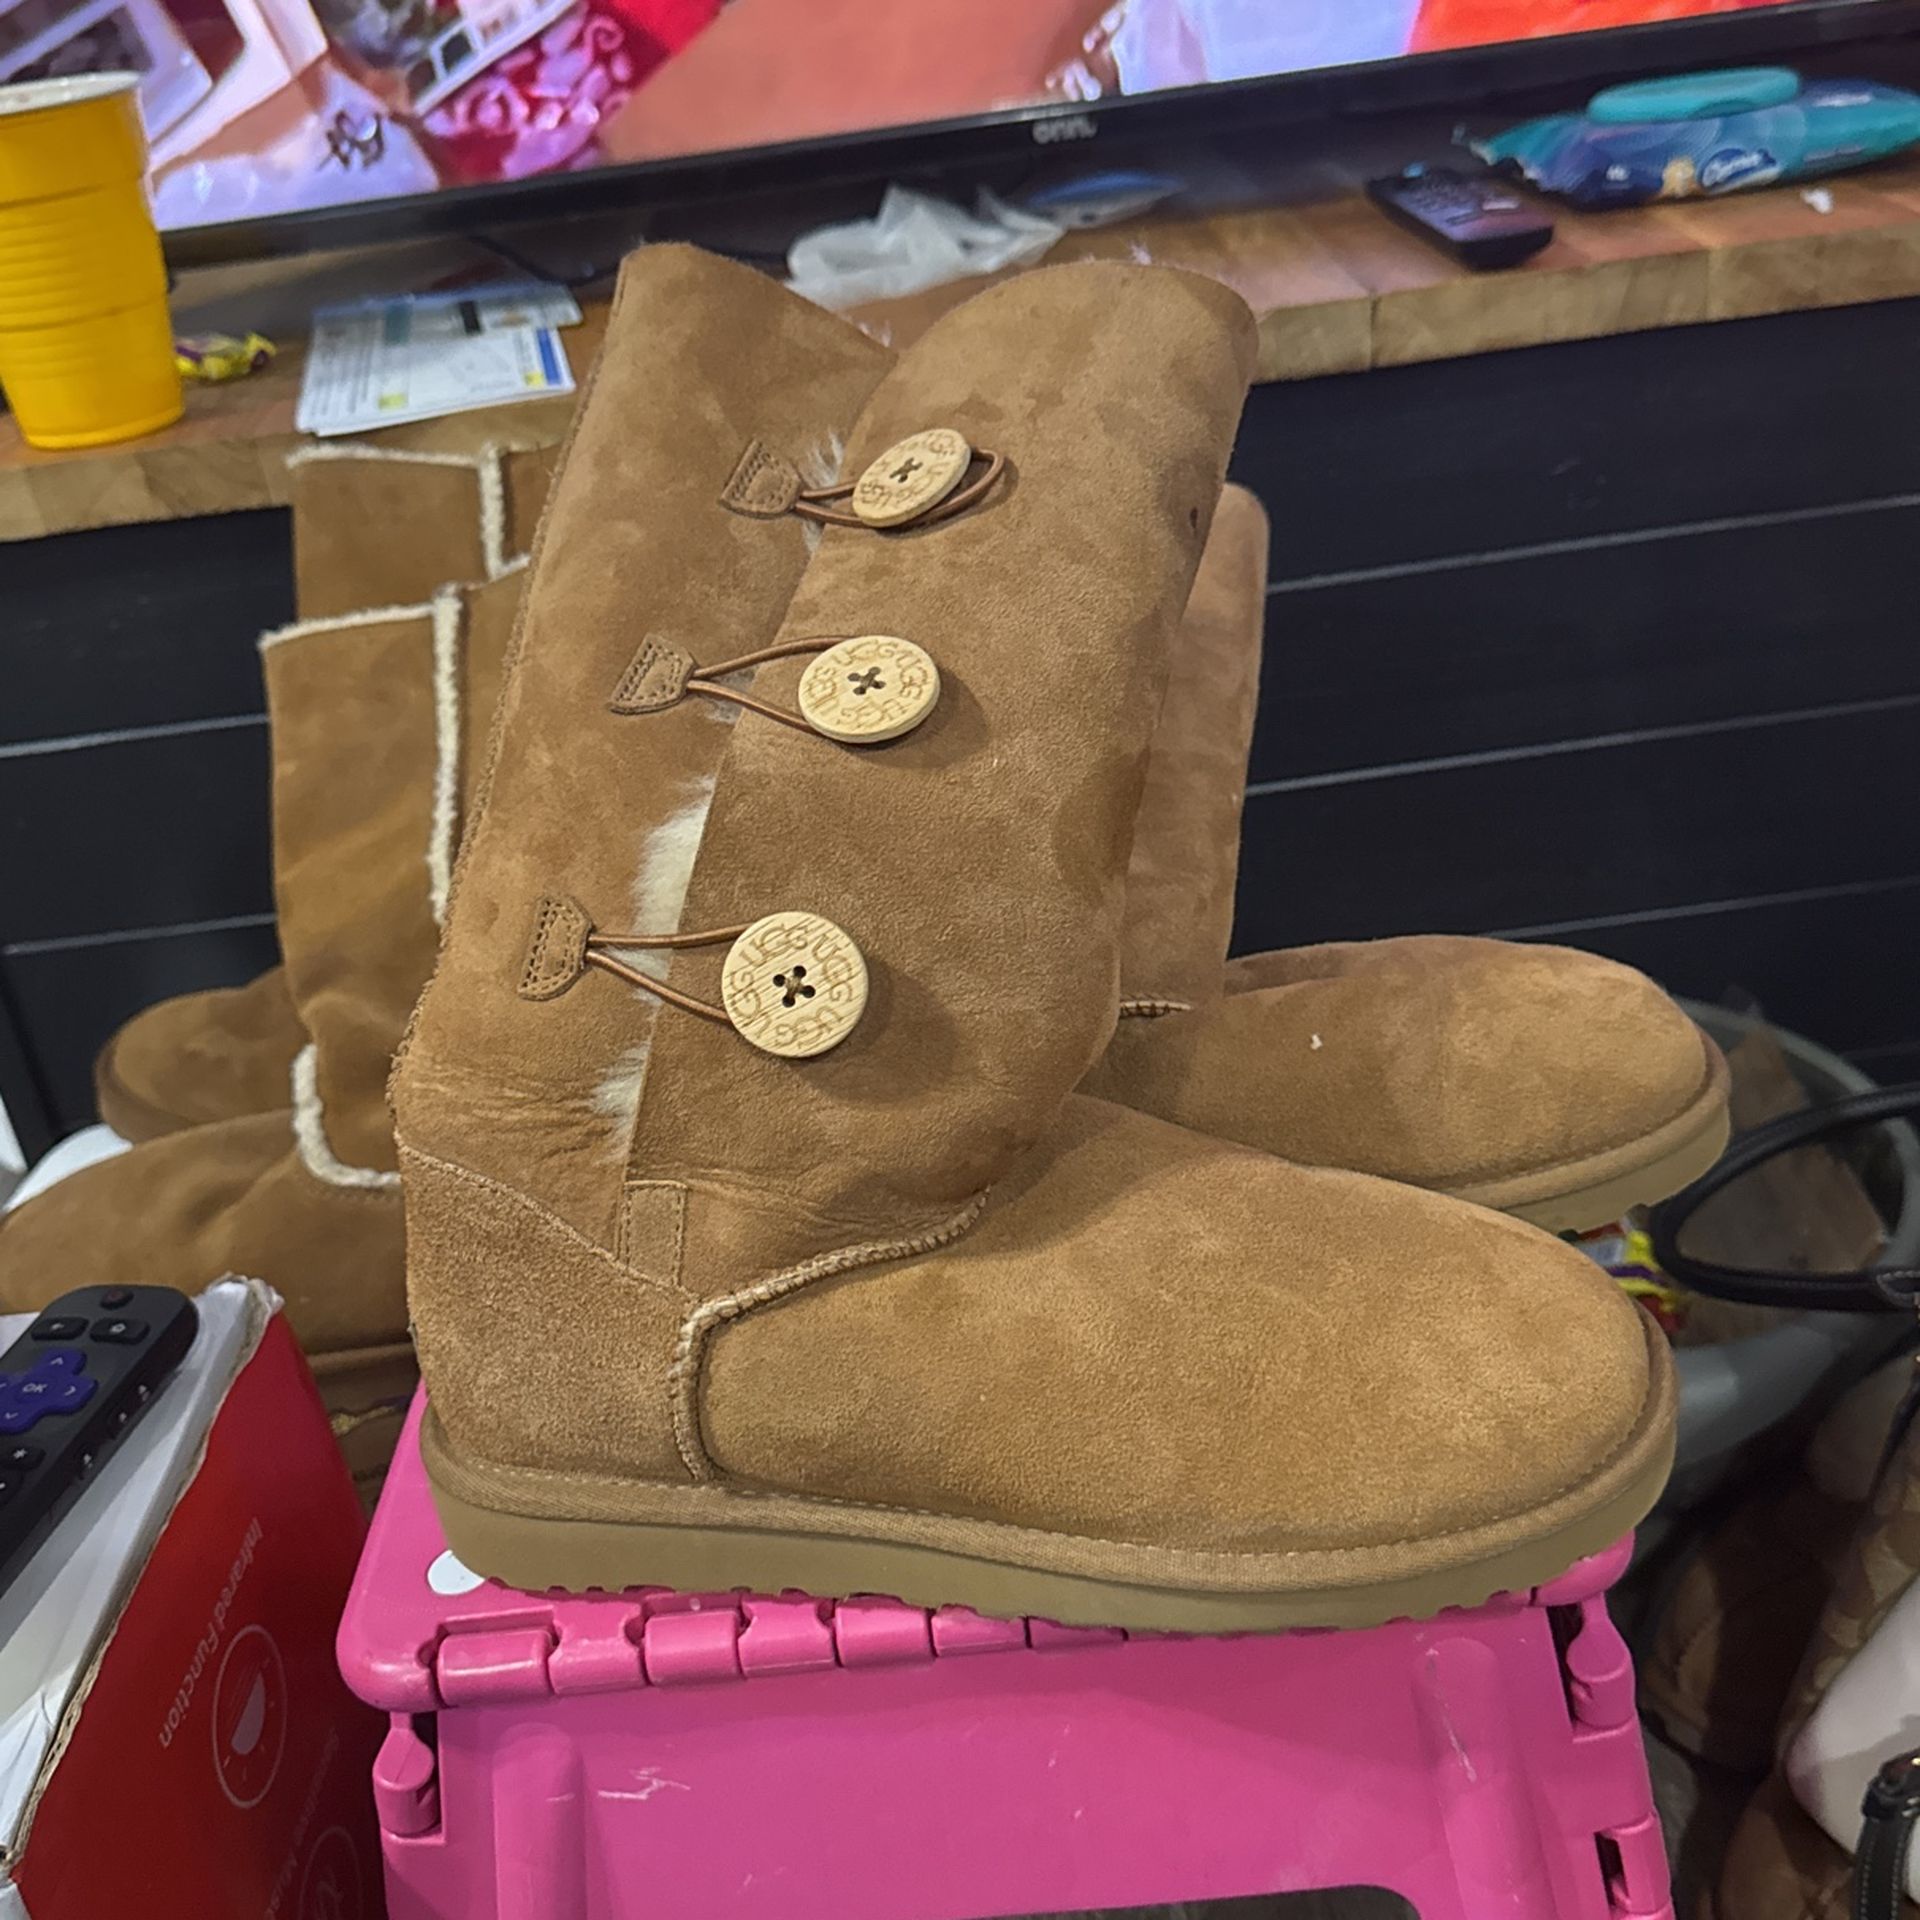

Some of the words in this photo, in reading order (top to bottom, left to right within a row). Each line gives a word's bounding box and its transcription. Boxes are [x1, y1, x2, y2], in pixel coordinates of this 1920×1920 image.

[22, 1383, 48, 1394] OK
[214, 1516, 264, 1630] Infrared
[159, 1621, 219, 1749] Function
